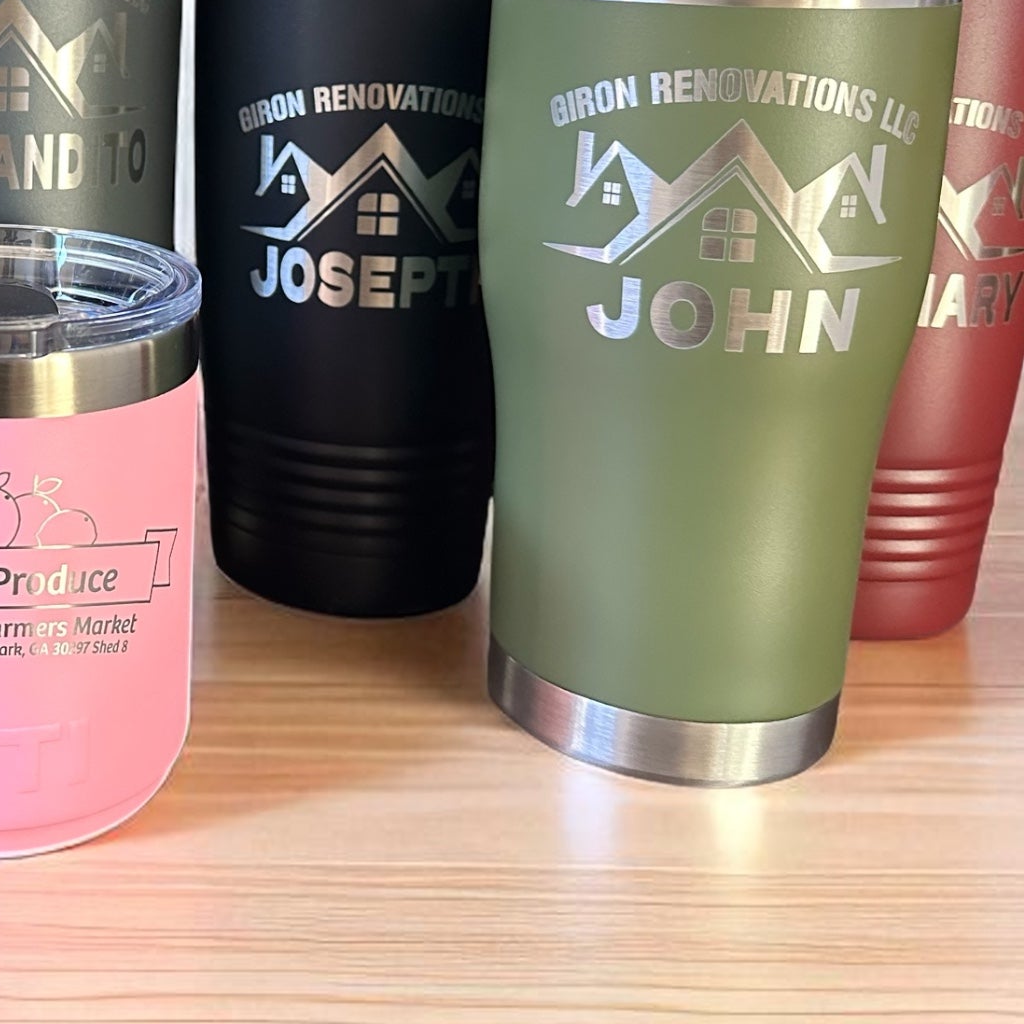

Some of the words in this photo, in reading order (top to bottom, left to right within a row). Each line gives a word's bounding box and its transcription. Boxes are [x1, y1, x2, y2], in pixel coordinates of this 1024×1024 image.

[238, 89, 306, 133] GIRON
[313, 83, 485, 124] RENOVATIONS
[550, 76, 638, 127] GIRON
[651, 68, 876, 123] RENOVATIONS
[879, 97, 921, 146] LLC
[948, 96, 1024, 140] TIONS
[586, 276, 860, 354] JOHN
[29, 641, 49, 656] GA
[92, 639, 120, 654] Shed
[121, 639, 128, 653] 8
[73, 613, 137, 636] Market
